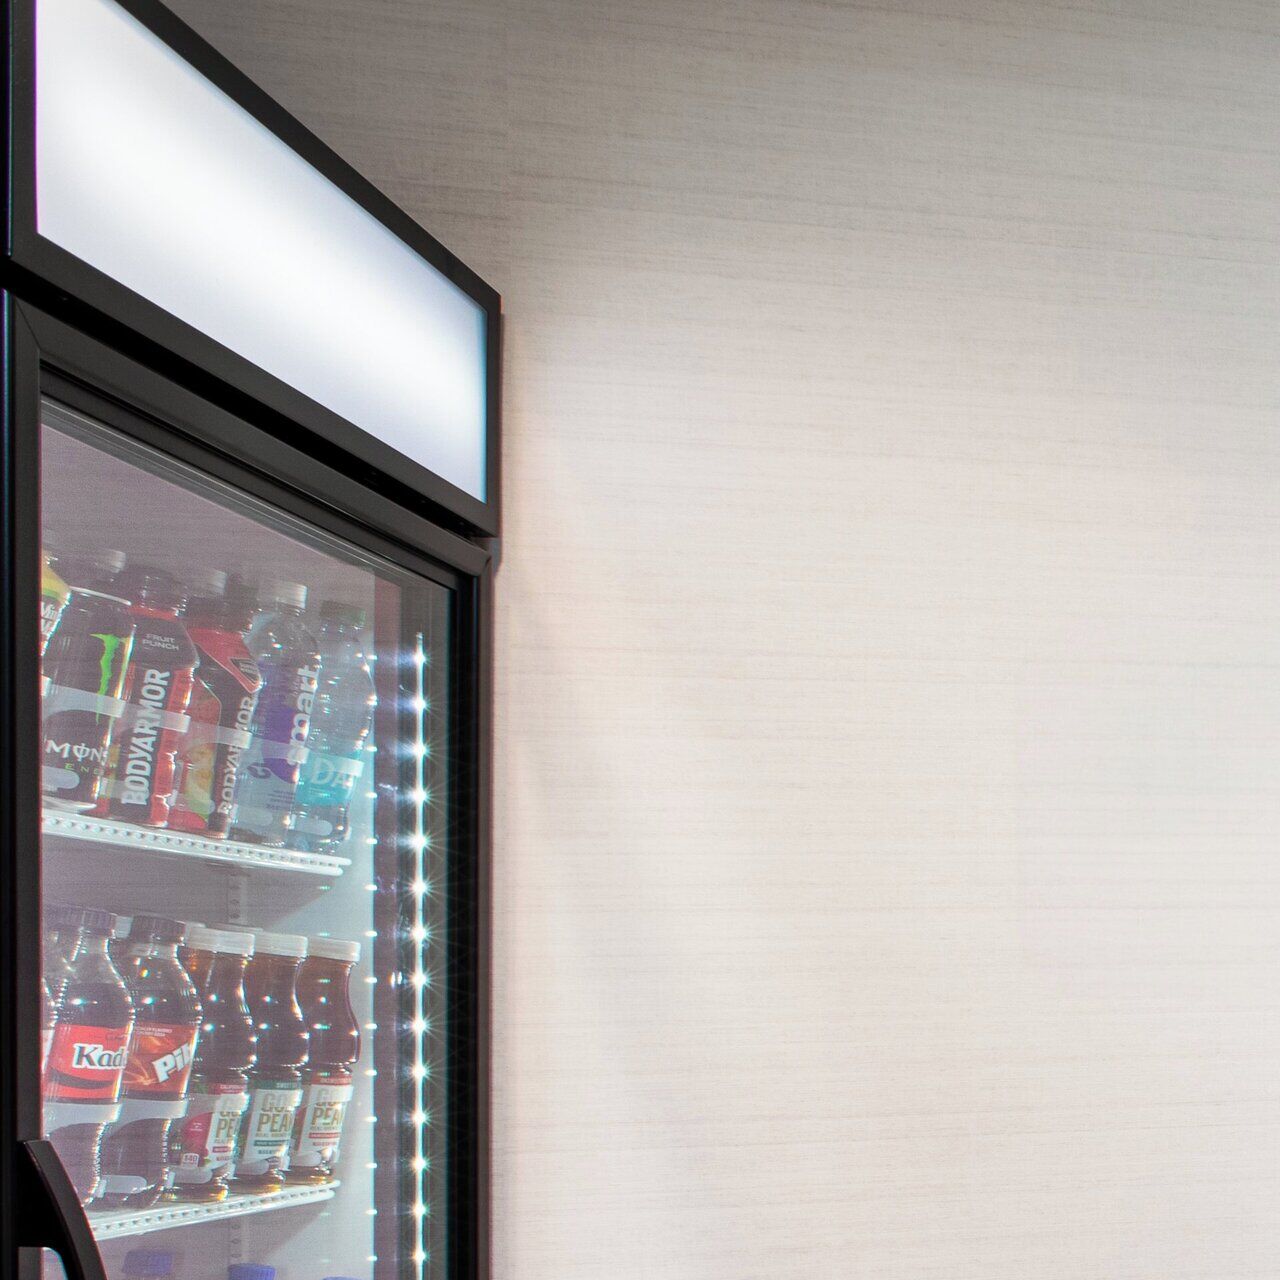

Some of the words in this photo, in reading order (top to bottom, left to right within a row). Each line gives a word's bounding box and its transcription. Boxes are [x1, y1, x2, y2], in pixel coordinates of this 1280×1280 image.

[142, 639, 180, 652] PUNCH
[145, 632, 176, 645] FRUIT
[121, 668, 171, 806] BODYARMOR
[286, 665, 319, 766] smart
